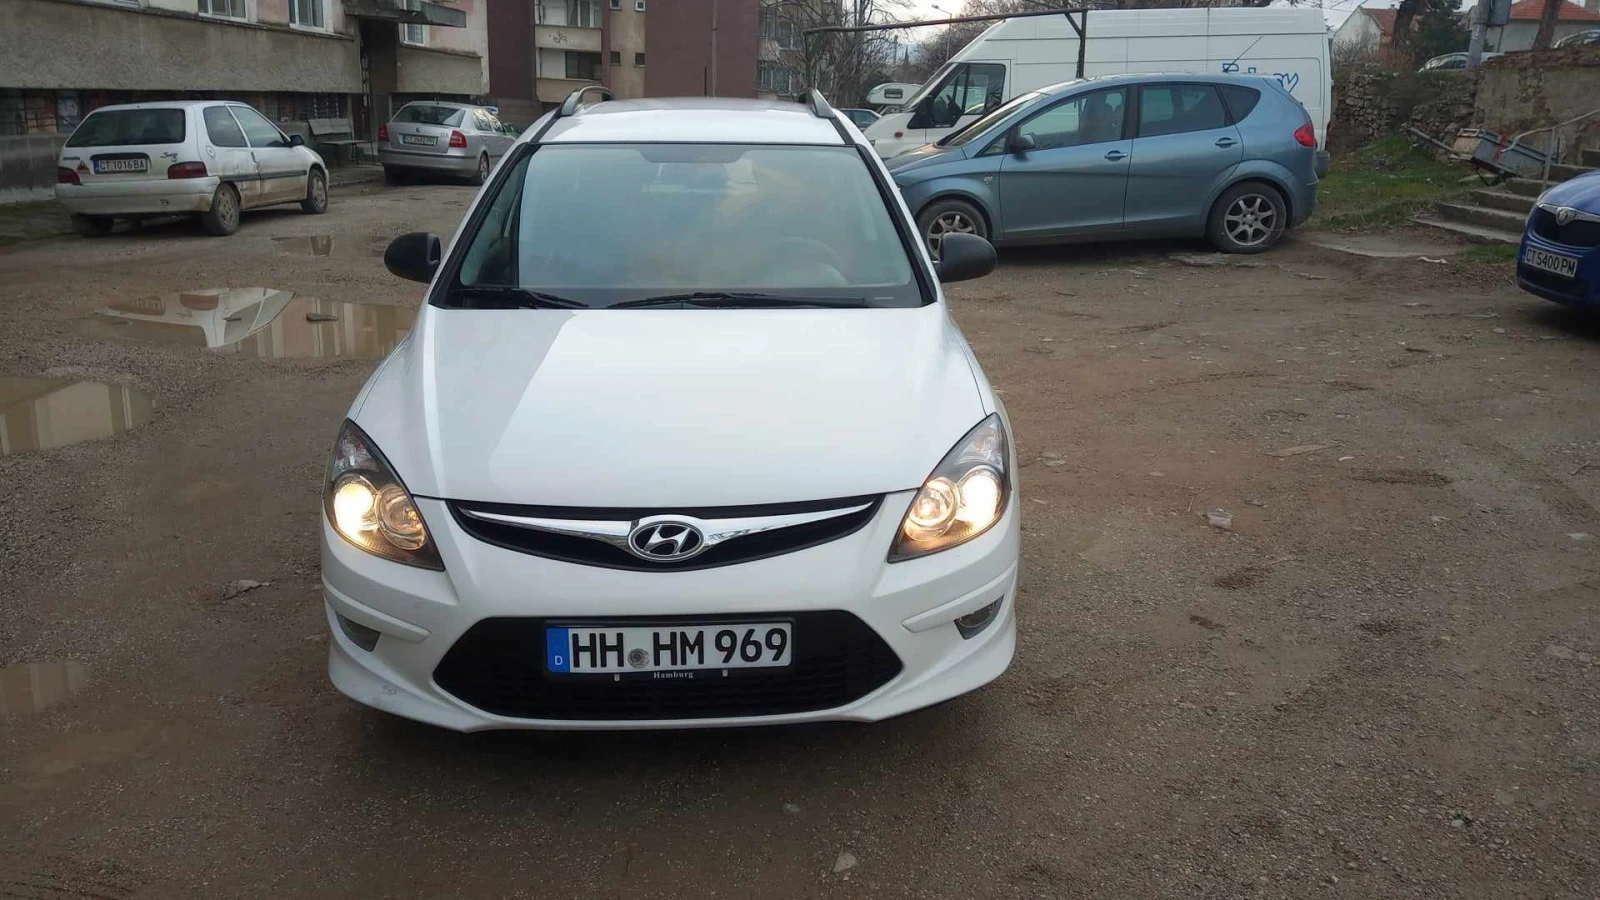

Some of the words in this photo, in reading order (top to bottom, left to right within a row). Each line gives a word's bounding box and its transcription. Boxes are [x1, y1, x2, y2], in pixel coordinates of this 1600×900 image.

[99, 160, 110, 171] CT
[113, 160, 133, 170] 1016
[133, 159, 145, 169] BA
[1526, 248, 1537, 264] CT
[1536, 251, 1560, 271] 5400
[1560, 257, 1576, 276] PM
[571, 632, 624, 668] HH
[652, 630, 704, 667] HM
[714, 627, 788, 664] 969
[554, 655, 563, 666] D
[653, 671, 694, 679] Hamburg
